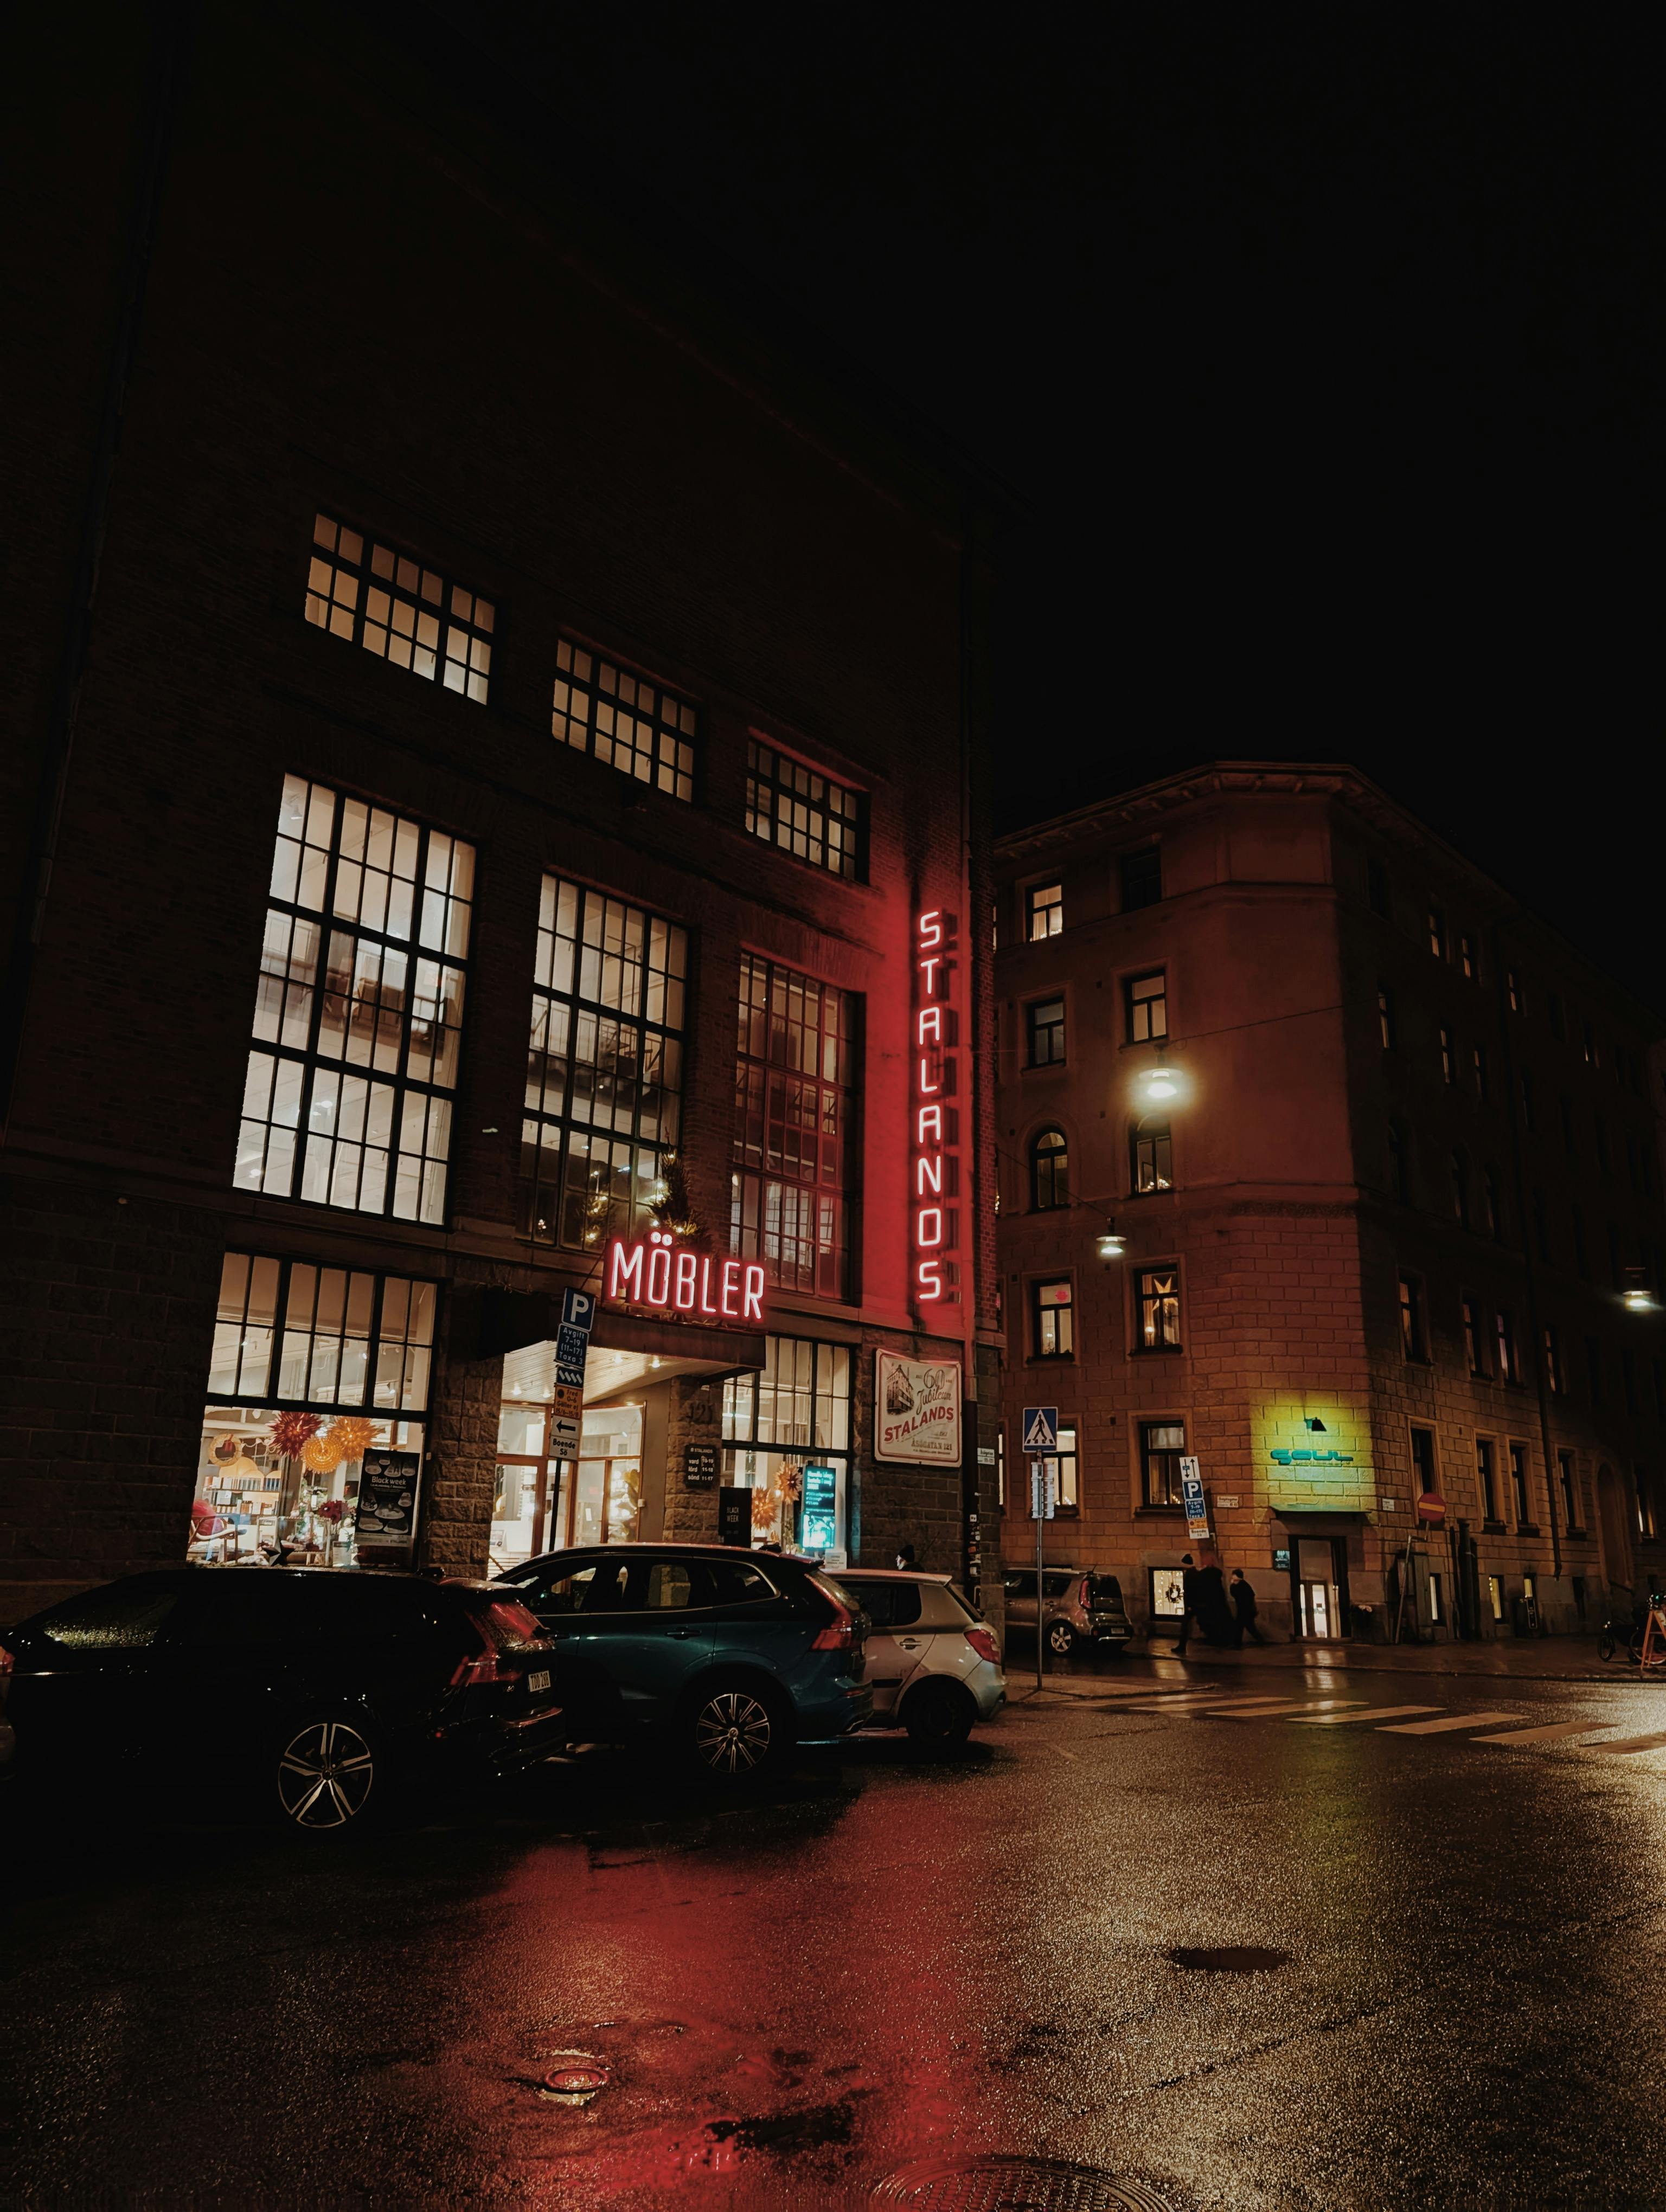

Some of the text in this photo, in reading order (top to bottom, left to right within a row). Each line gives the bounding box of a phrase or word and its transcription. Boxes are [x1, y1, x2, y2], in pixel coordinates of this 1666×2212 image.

[918, 911, 941, 1300] STALANDS
[611, 1231, 764, 1319] MÖBLER
[571, 1293, 589, 1322] P
[563, 1327, 585, 1339] Avgift
[559, 1352, 576, 1362] Taxa
[916, 1386, 952, 1416] Jubileum
[884, 1406, 954, 1442] STALANDS
[553, 1438, 576, 1449] Boende
[371, 1476, 389, 1484] Black
[1187, 1482, 1199, 1498] P
